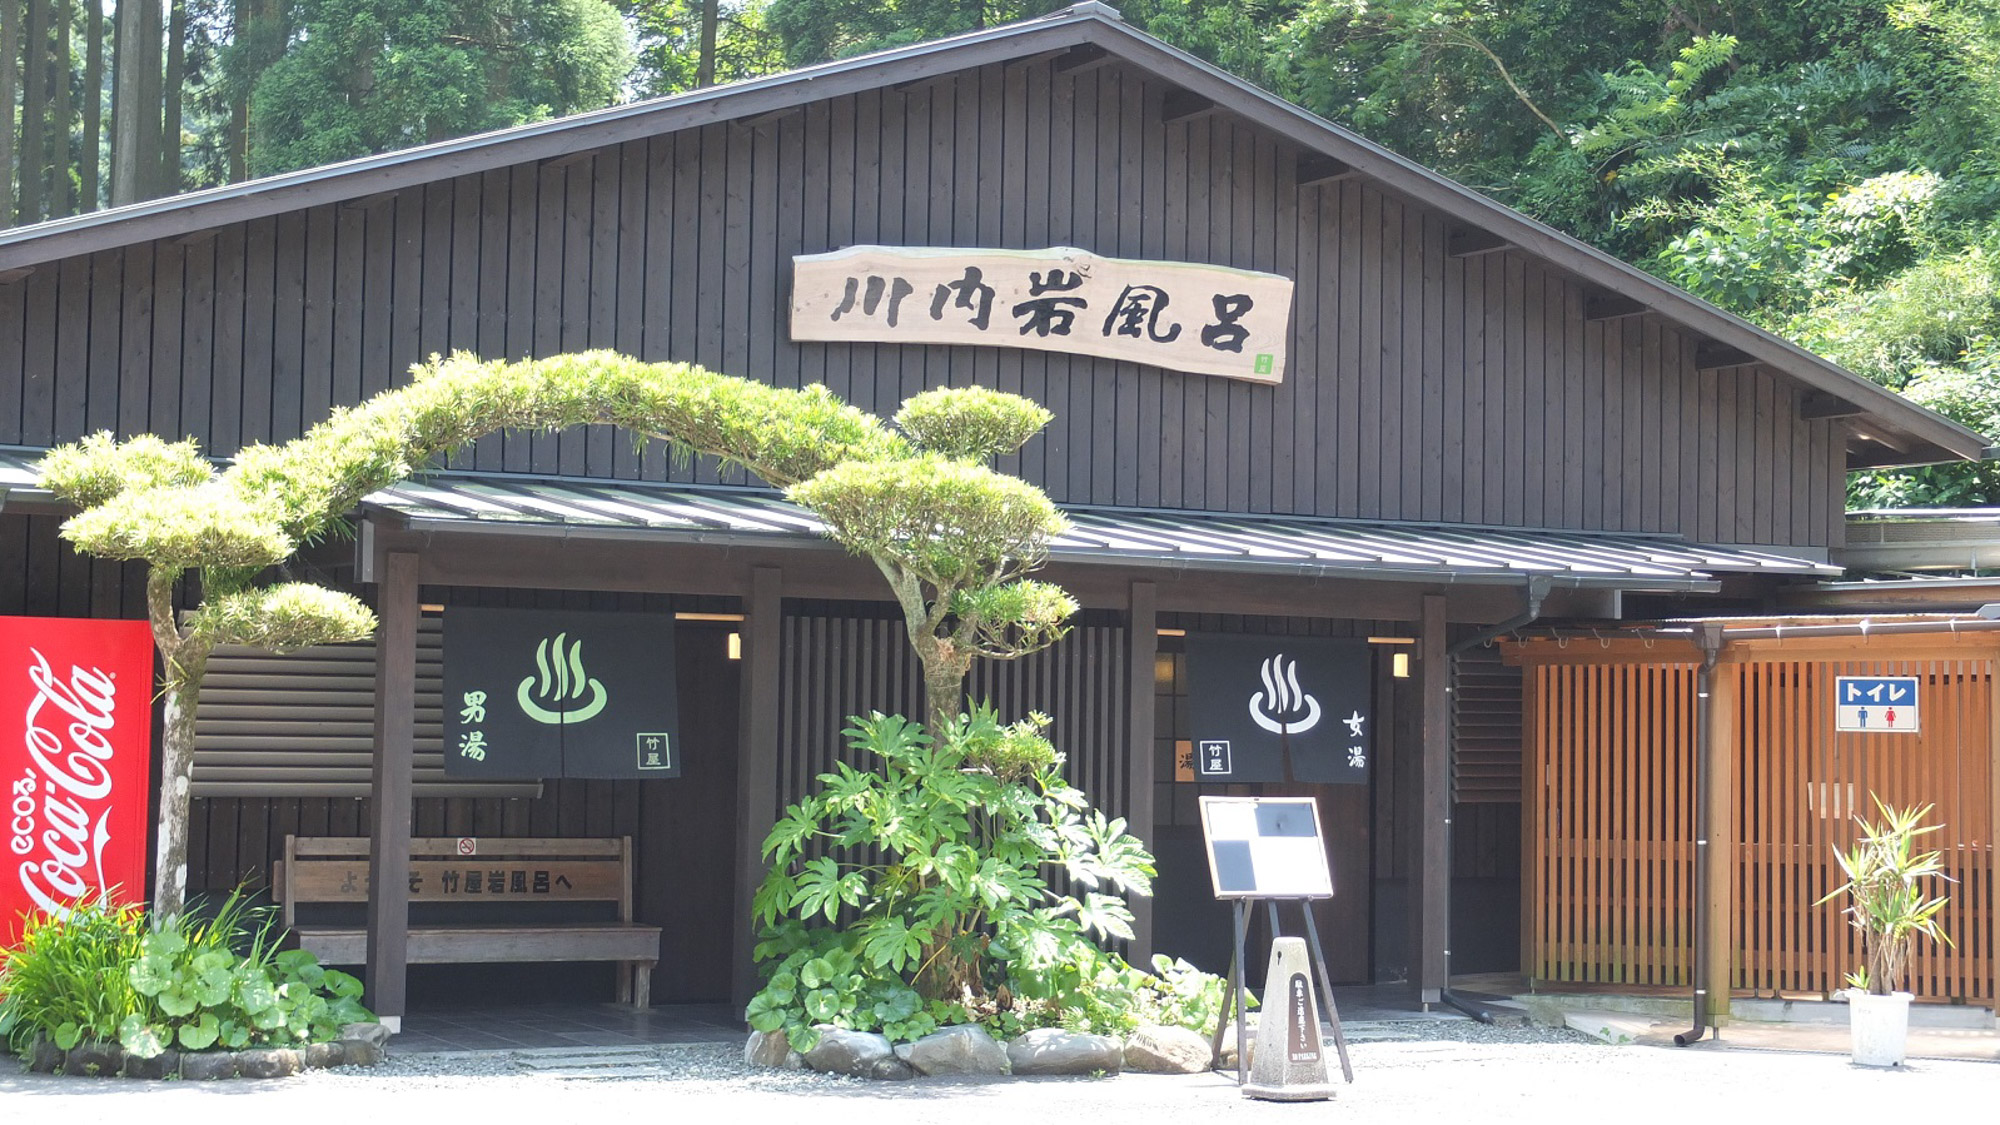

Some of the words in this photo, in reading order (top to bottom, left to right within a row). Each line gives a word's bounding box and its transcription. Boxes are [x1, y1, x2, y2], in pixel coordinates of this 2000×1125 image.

[831, 266, 1254, 353] 川内岩風呂
[1847, 682, 1907, 702] トイレ
[458, 690, 488, 762] 男湯
[1342, 710, 1367, 768] 女湯
[645, 737, 661, 766] 竹屋
[1208, 744, 1224, 771] 竹屋
[19, 647, 116, 922] Coca-Cola
[441, 870, 573, 894] 竹屋岩風呂へ
